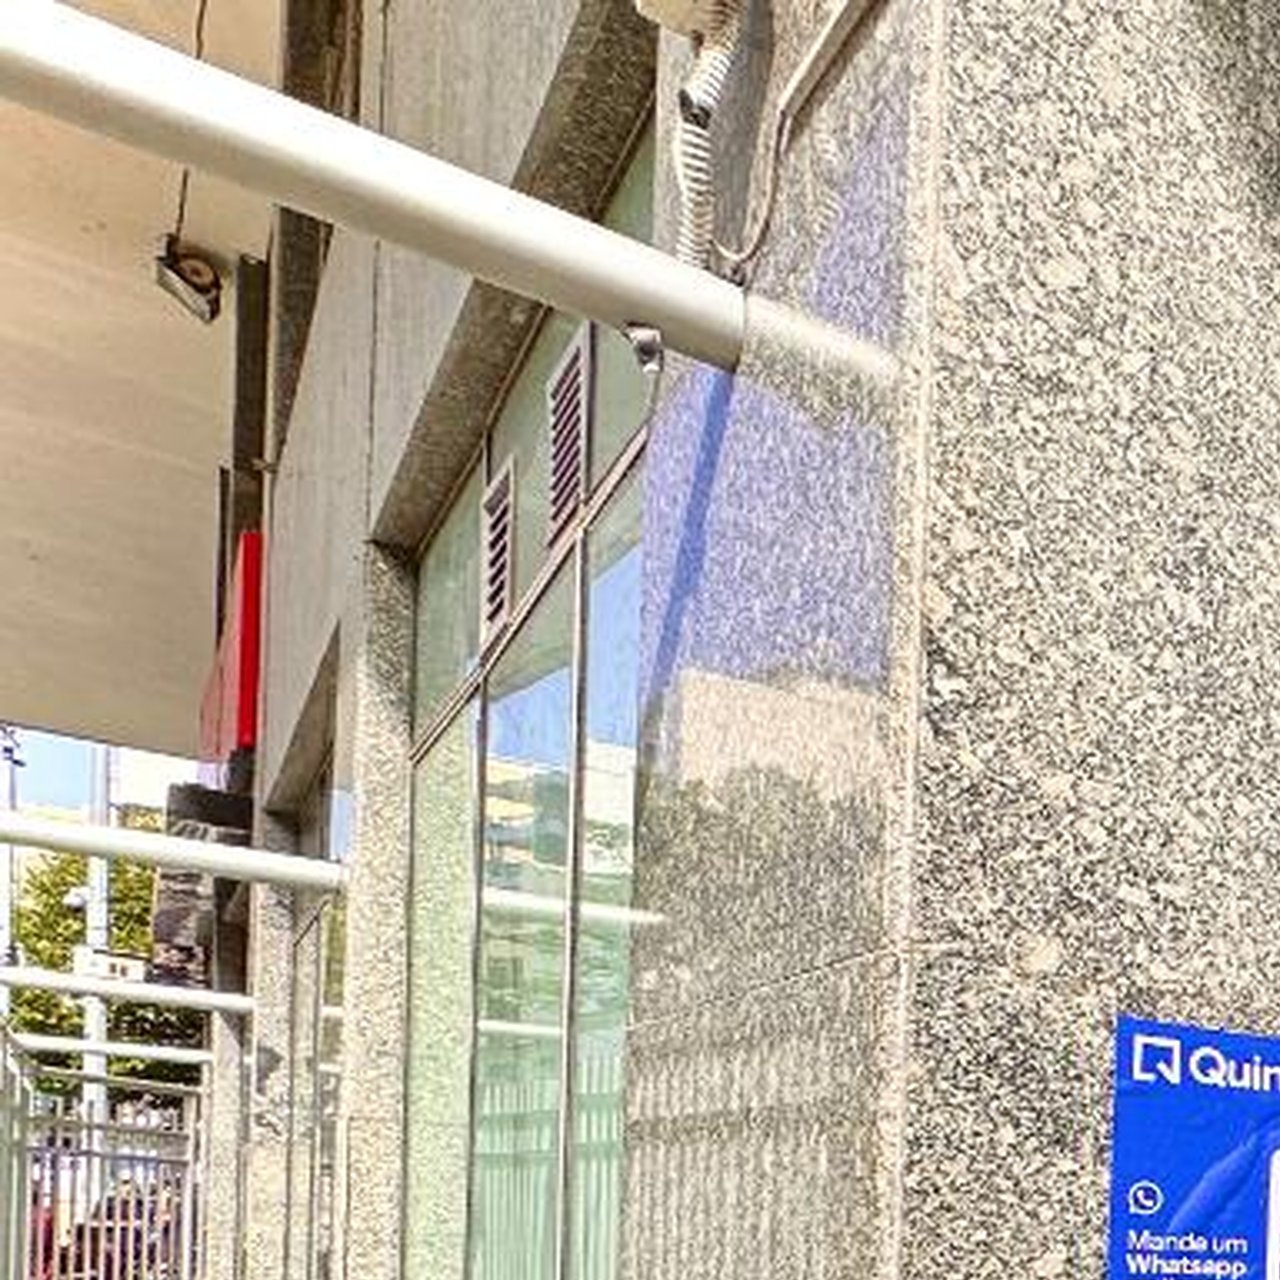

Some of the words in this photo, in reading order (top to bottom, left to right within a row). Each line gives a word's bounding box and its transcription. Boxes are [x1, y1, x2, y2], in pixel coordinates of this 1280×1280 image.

[1128, 1229, 1208, 1252] Mande
[1212, 1236, 1248, 1254] um
[1126, 1253, 1247, 1280] Whatsapp
